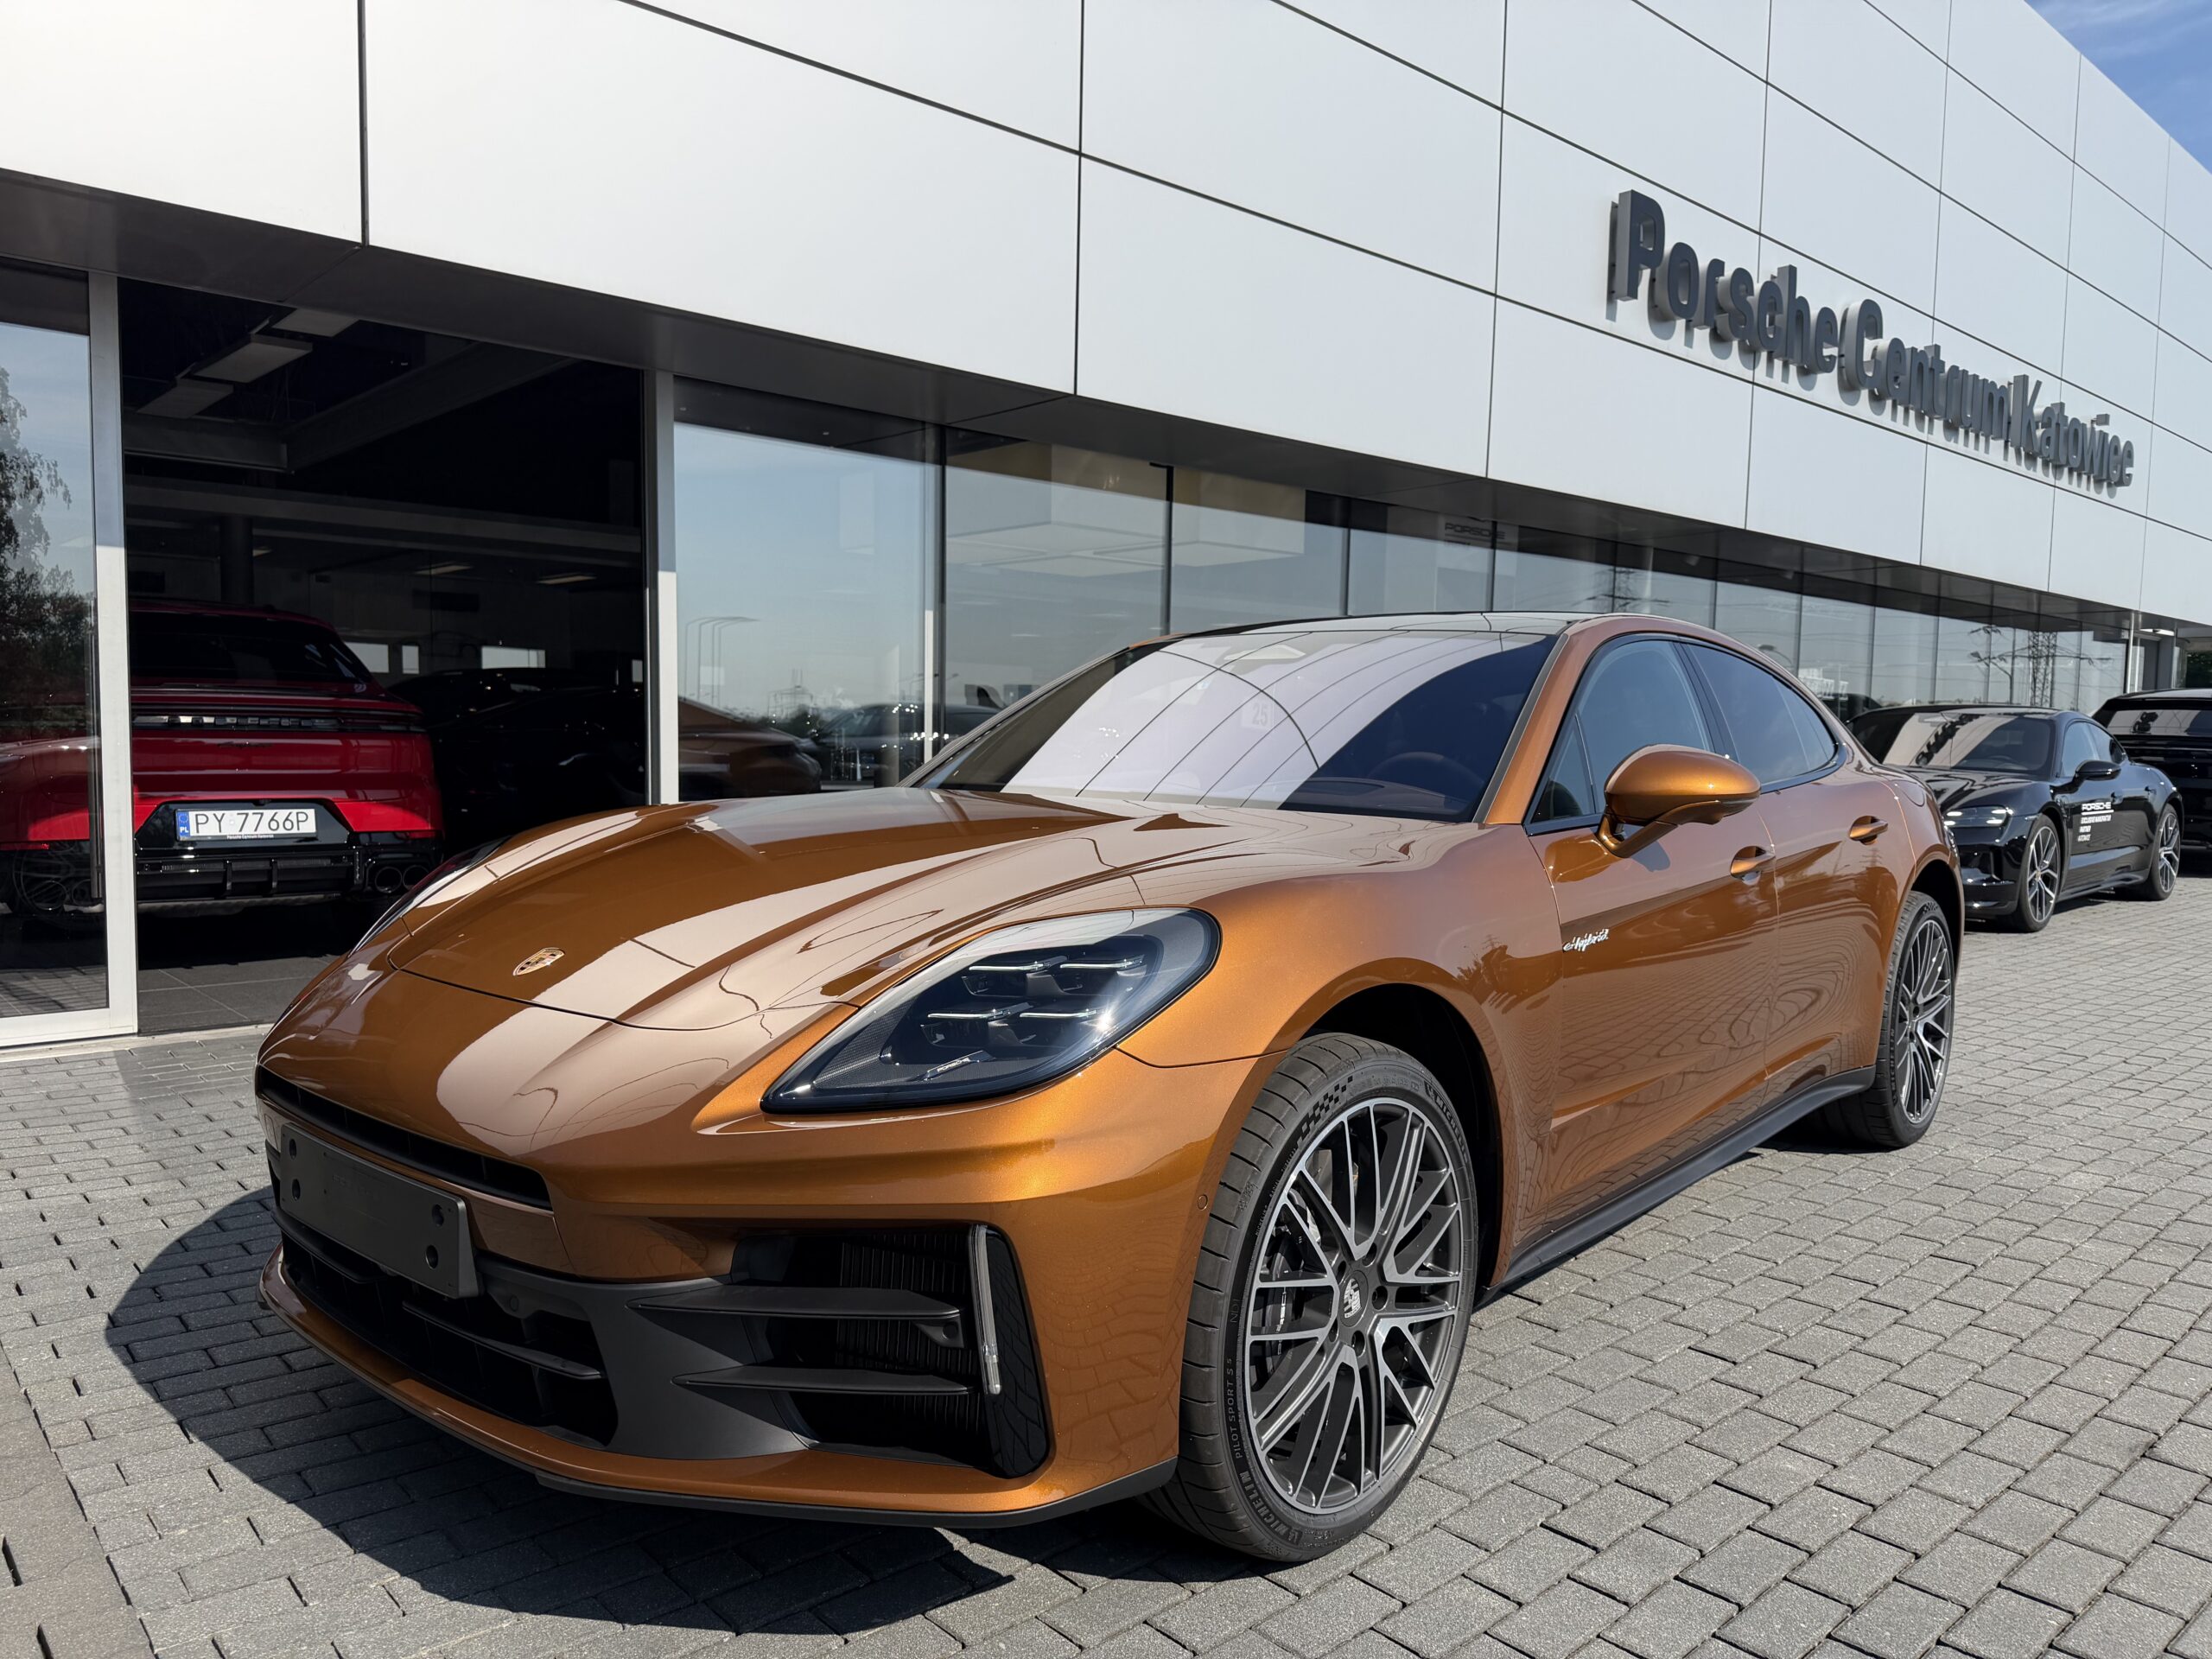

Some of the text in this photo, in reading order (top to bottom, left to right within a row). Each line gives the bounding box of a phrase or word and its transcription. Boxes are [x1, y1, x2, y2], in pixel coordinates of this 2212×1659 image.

[1616, 189, 2134, 486] Porsche Centrum Katowice
[1251, 702, 1268, 727] 25
[194, 811, 309, 834] PY 7766P
[1226, 1381, 1236, 1422] SPORT
[1230, 1427, 1243, 1459] PILOT
[1240, 1471, 1288, 1535] MICHELIN
